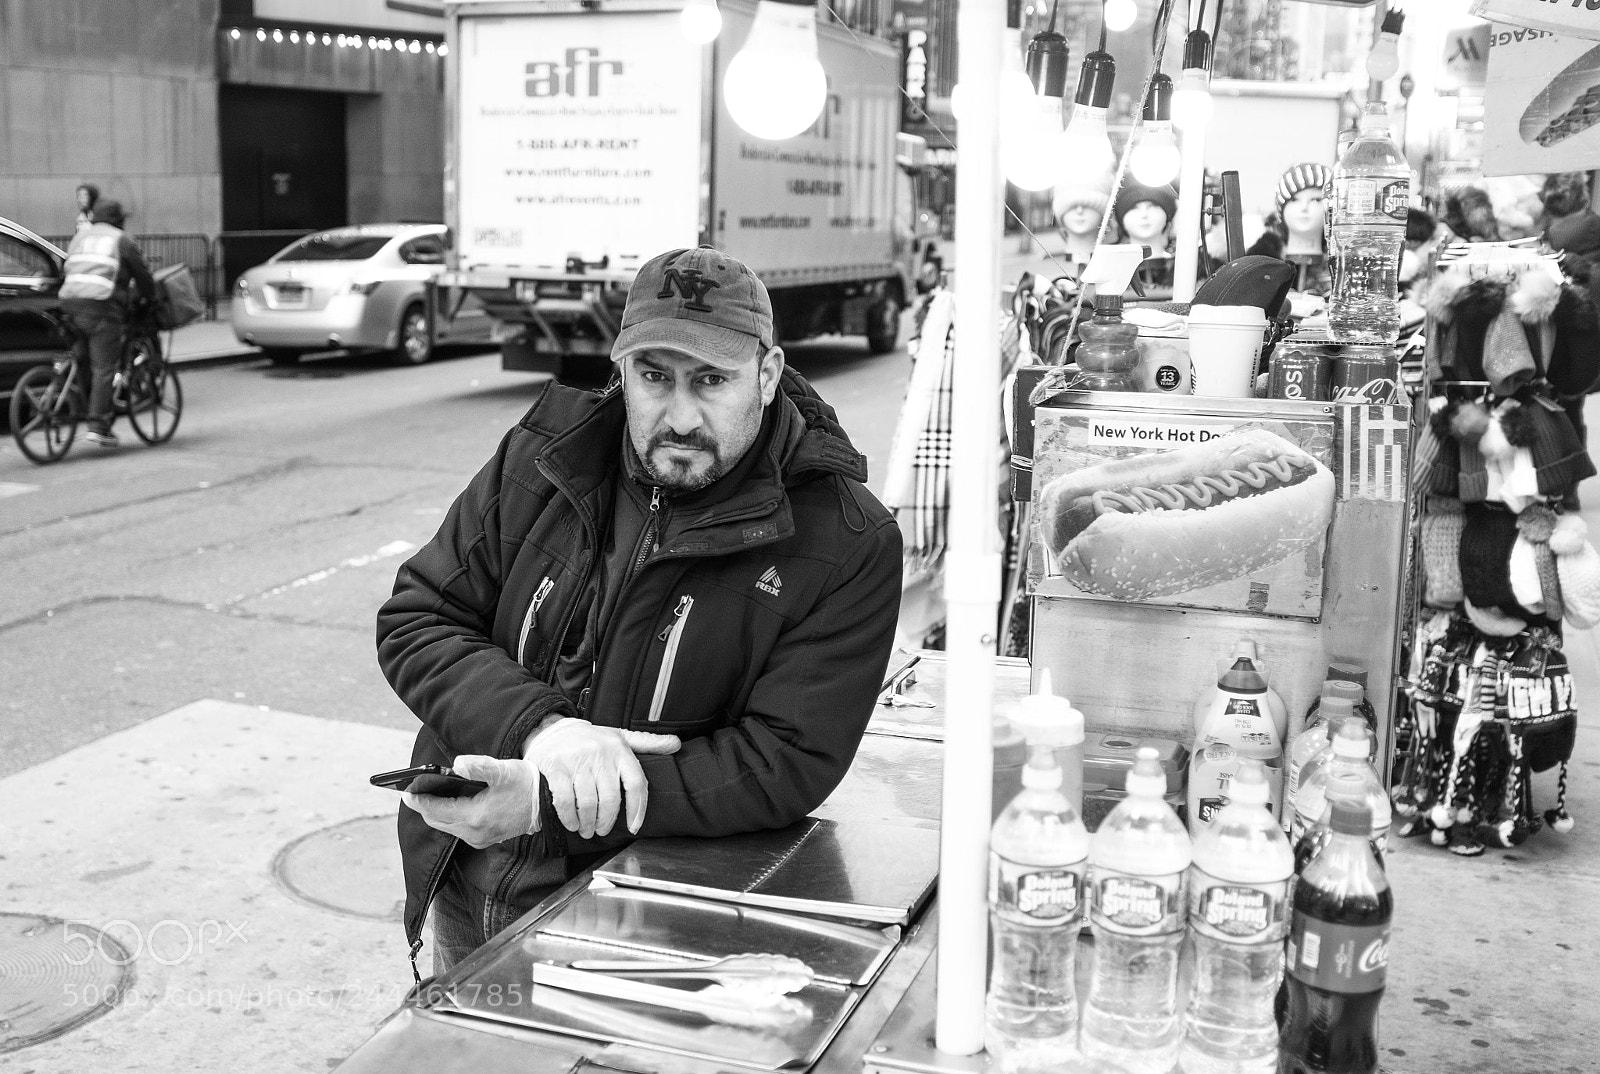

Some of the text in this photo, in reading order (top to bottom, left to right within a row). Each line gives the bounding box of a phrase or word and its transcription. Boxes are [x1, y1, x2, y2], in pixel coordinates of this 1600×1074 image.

[525, 47, 623, 97] afr
[657, 268, 720, 313] NY
[1160, 371, 1176, 382] 13
[1094, 424, 1222, 443] New York Hot Do
[1019, 889, 1077, 912] Spring
[1102, 894, 1162, 922] Spring
[1206, 902, 1267, 930] Spring
